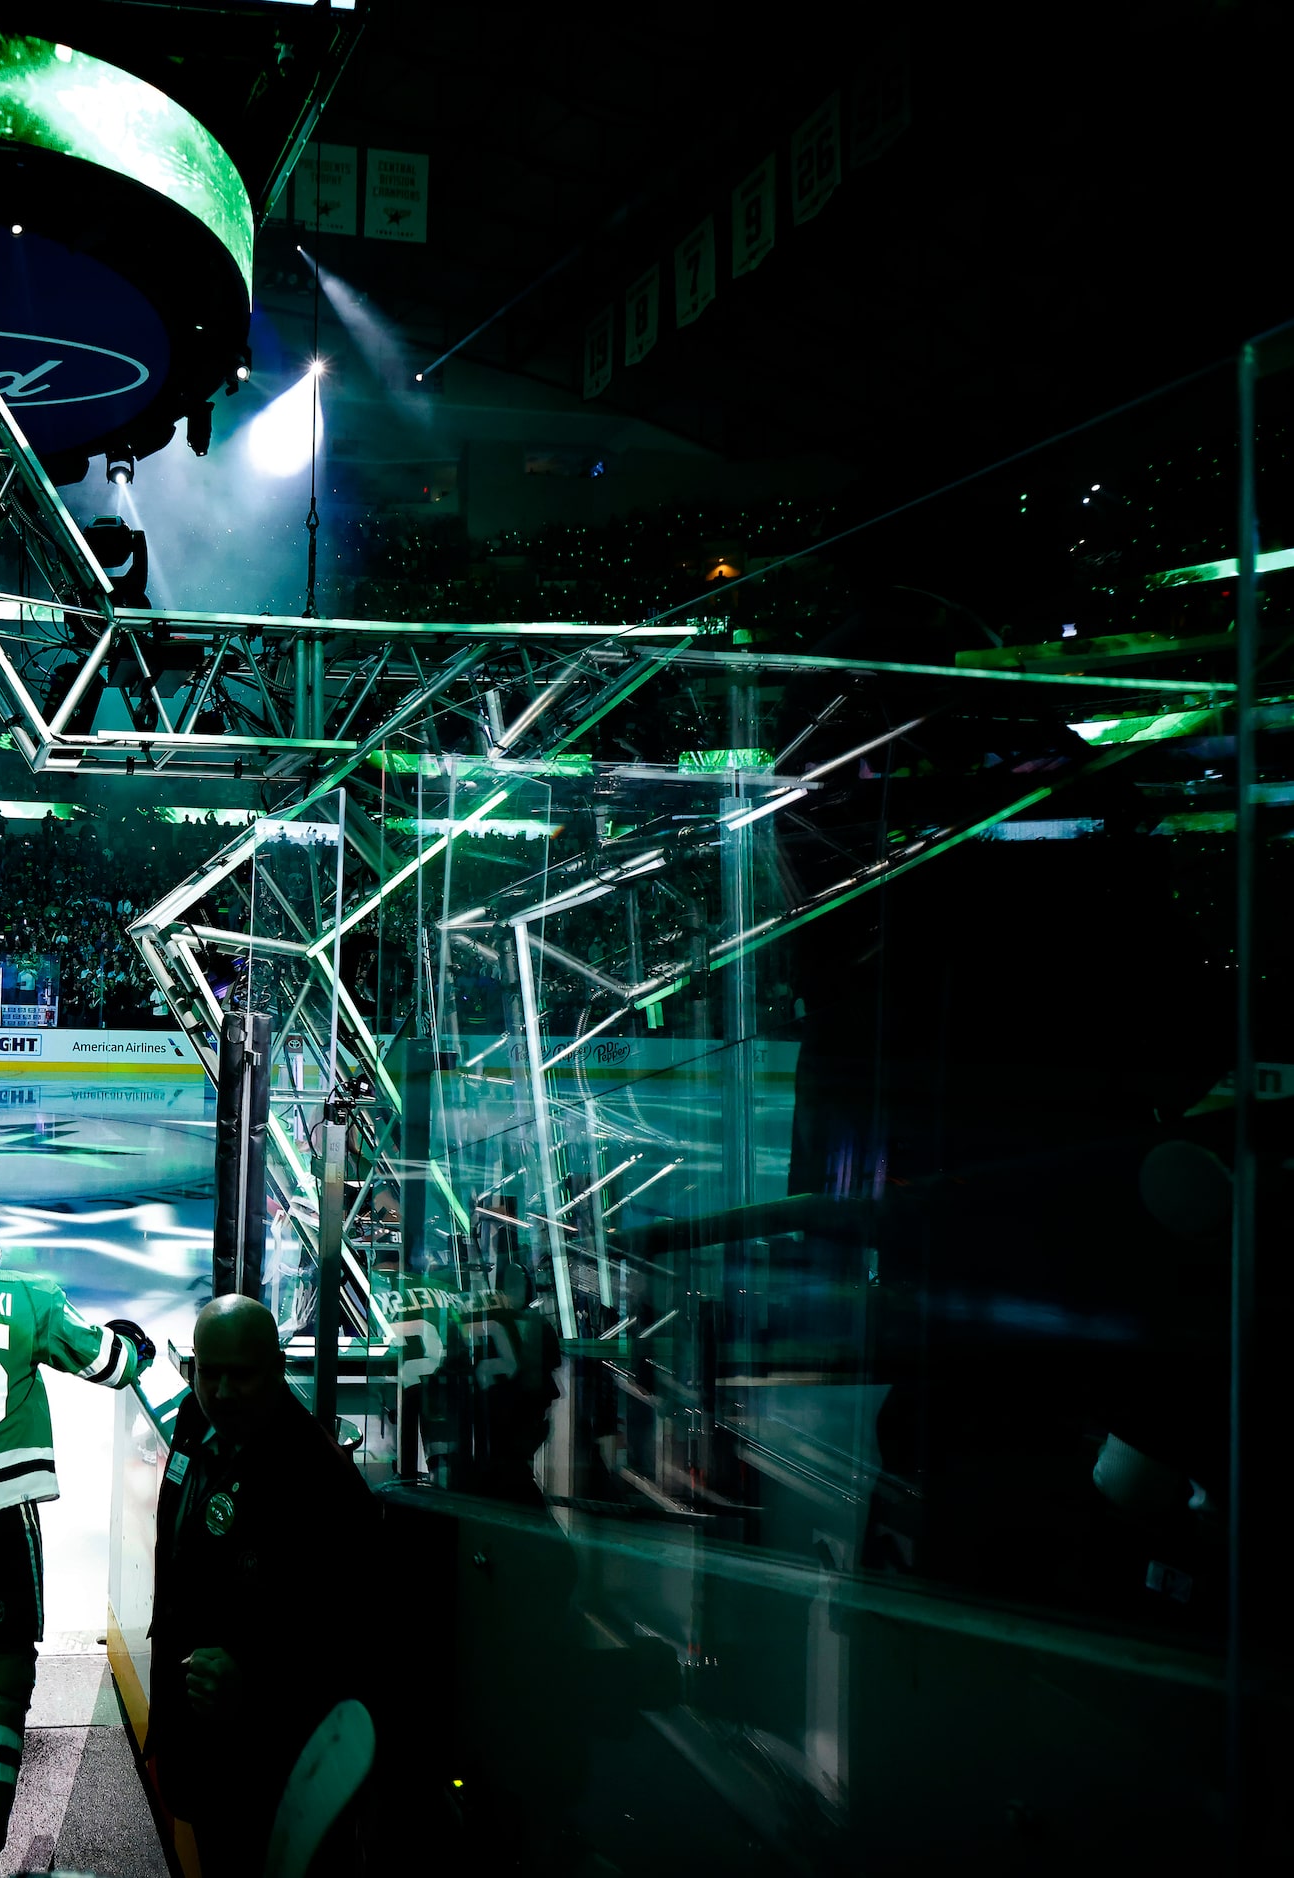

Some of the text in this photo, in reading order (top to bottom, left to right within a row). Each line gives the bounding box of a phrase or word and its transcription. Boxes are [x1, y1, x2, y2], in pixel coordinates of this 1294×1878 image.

[377, 160, 416, 175] CENTRAL
[797, 128, 834, 203] 26
[744, 196, 762, 248] 9
[686, 251, 701, 298] 7
[72, 1041, 167, 1053] American Airlines
[596, 1041, 628, 1064] Dr Pepper
